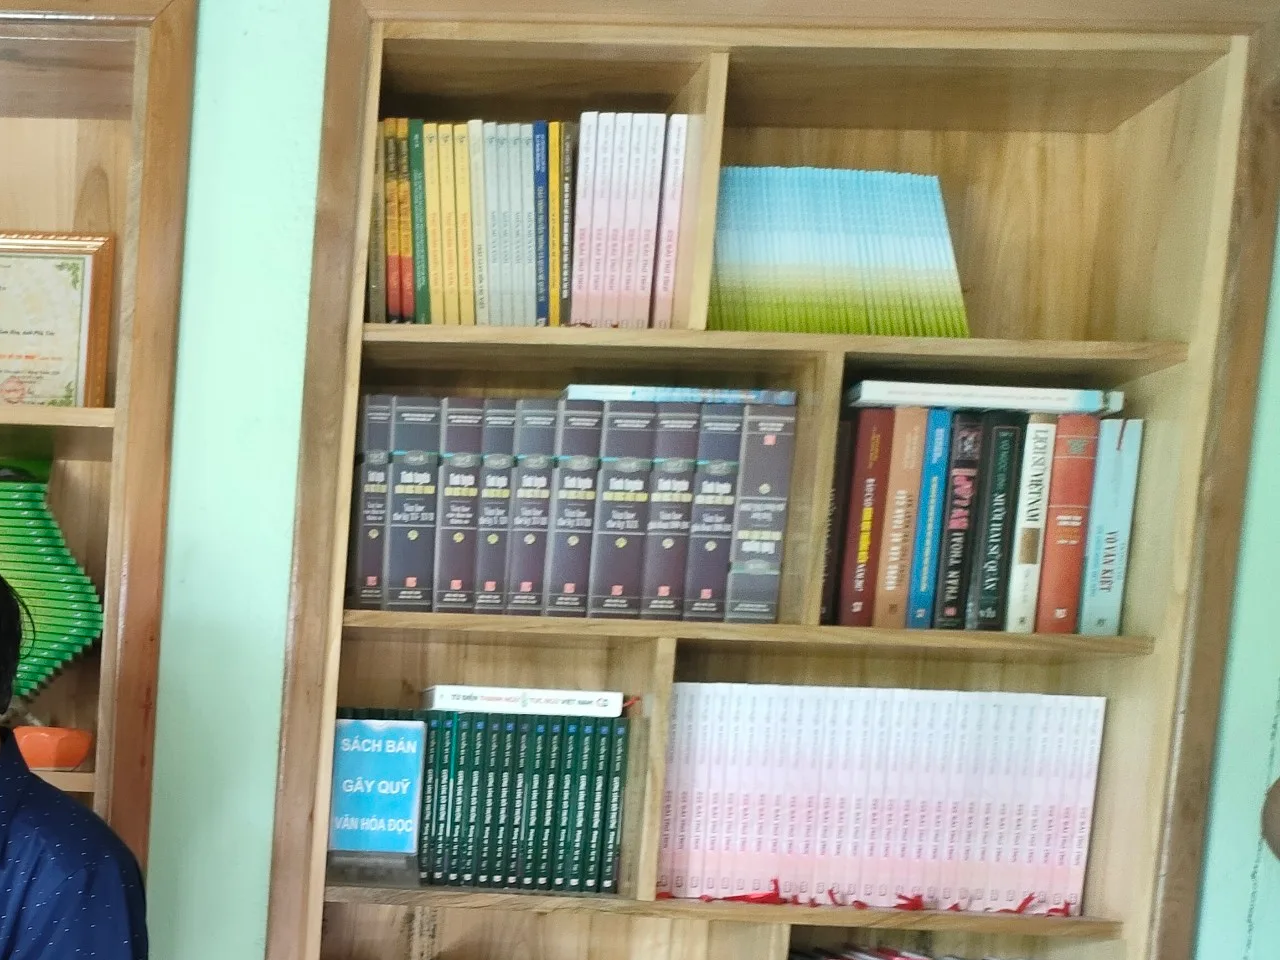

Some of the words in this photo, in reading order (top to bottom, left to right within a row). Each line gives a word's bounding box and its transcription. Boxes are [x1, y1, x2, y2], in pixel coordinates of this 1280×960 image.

[341, 736, 382, 753] SÁCH
[385, 737, 417, 754] BÁN
[342, 777, 375, 793] GÂY
[377, 779, 411, 794] QUỸ
[334, 814, 359, 830] VĂN
[360, 815, 386, 831] HÓA
[387, 819, 414, 834] ĐỌC
